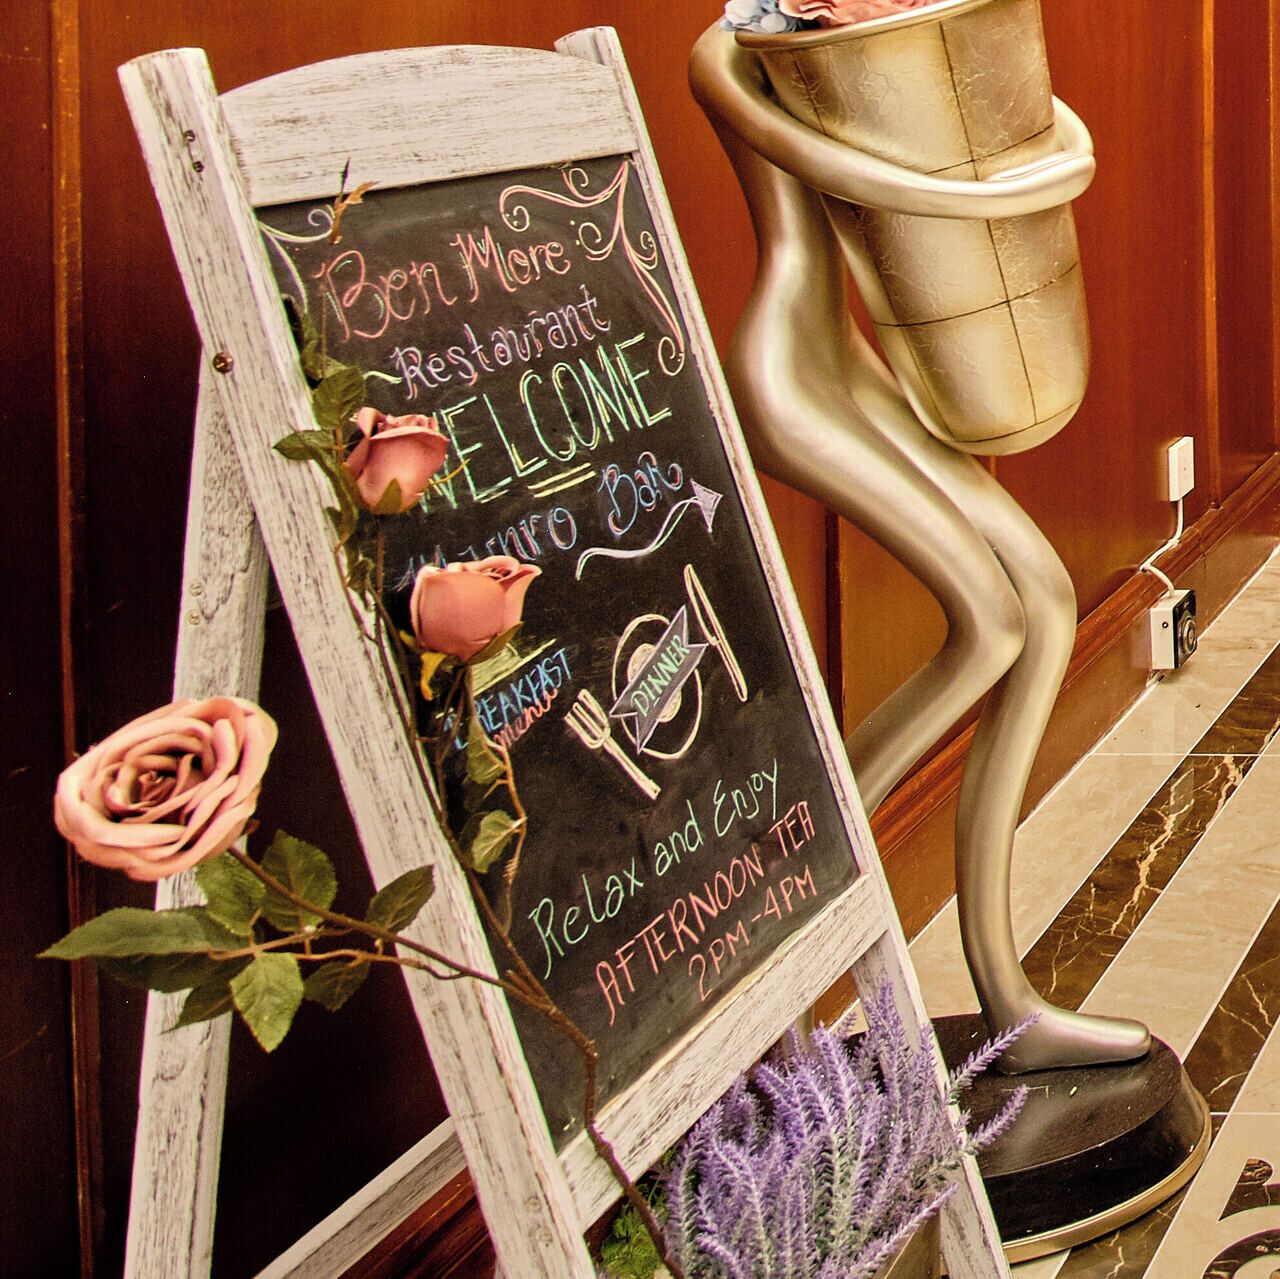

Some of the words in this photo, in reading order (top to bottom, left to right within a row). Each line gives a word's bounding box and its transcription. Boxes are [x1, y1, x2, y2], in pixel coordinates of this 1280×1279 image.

[312, 250, 458, 343] Ben
[449, 225, 571, 304] More
[390, 283, 611, 401] Restaurant
[630, 634, 690, 718] DINNER
[528, 855, 644, 981] Relax
[654, 799, 704, 876] and
[713, 758, 778, 837] Enjoy
[595, 843, 765, 1027] AFTERNOON
[768, 800, 816, 858] TEA
